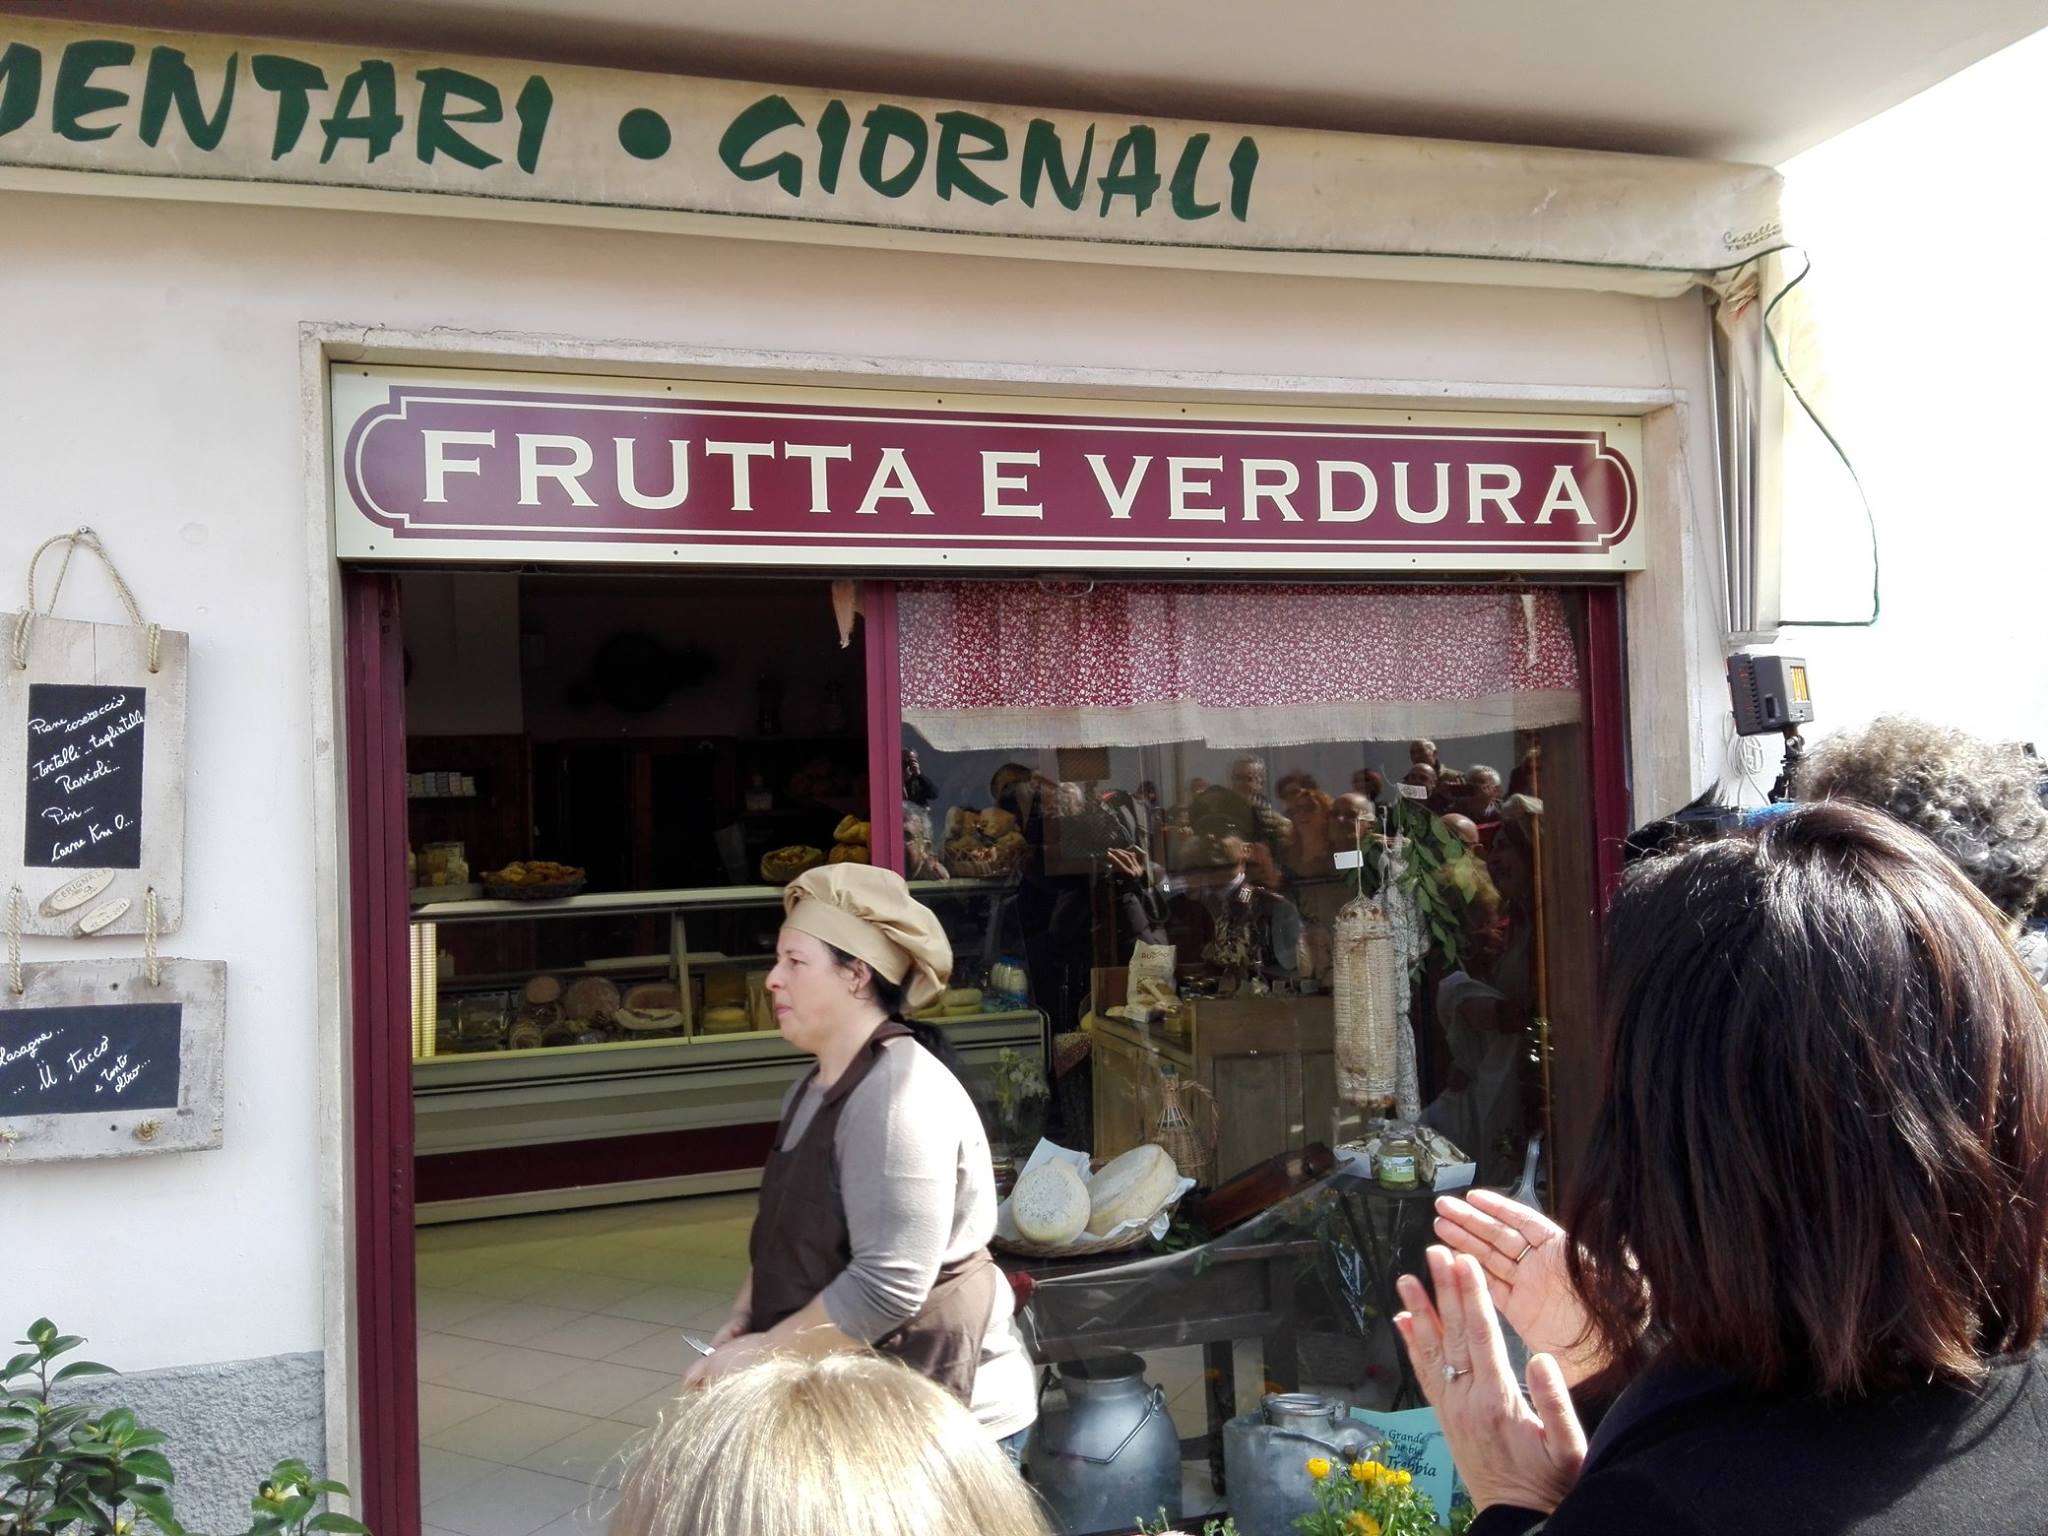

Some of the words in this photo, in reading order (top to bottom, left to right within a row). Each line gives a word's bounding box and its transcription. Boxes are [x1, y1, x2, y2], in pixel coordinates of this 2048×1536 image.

[718, 94, 1260, 223] GIORNALI
[421, 429, 935, 515] FRUTTA
[980, 449, 1044, 520] E
[1083, 454, 1598, 526] VERDURA
[28, 717, 68, 735] Pane
[88, 823, 113, 844] Km
